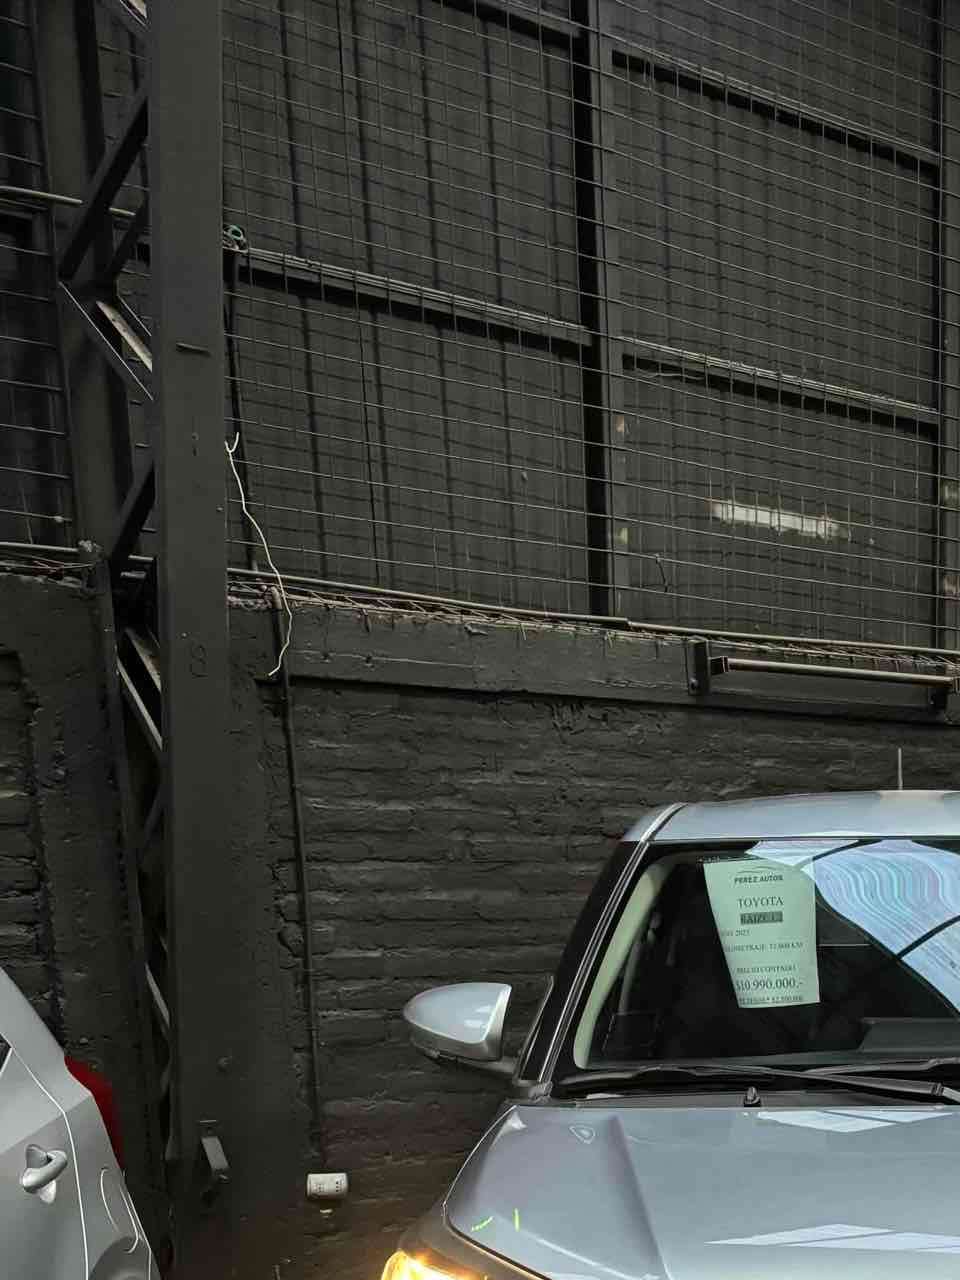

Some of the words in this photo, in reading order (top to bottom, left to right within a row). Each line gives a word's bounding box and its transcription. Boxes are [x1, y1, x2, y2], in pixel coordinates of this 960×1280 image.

[734, 876, 759, 884] PEREZ
[760, 874, 784, 882] AUTOS
[736, 896, 784, 909] TOYOTA
